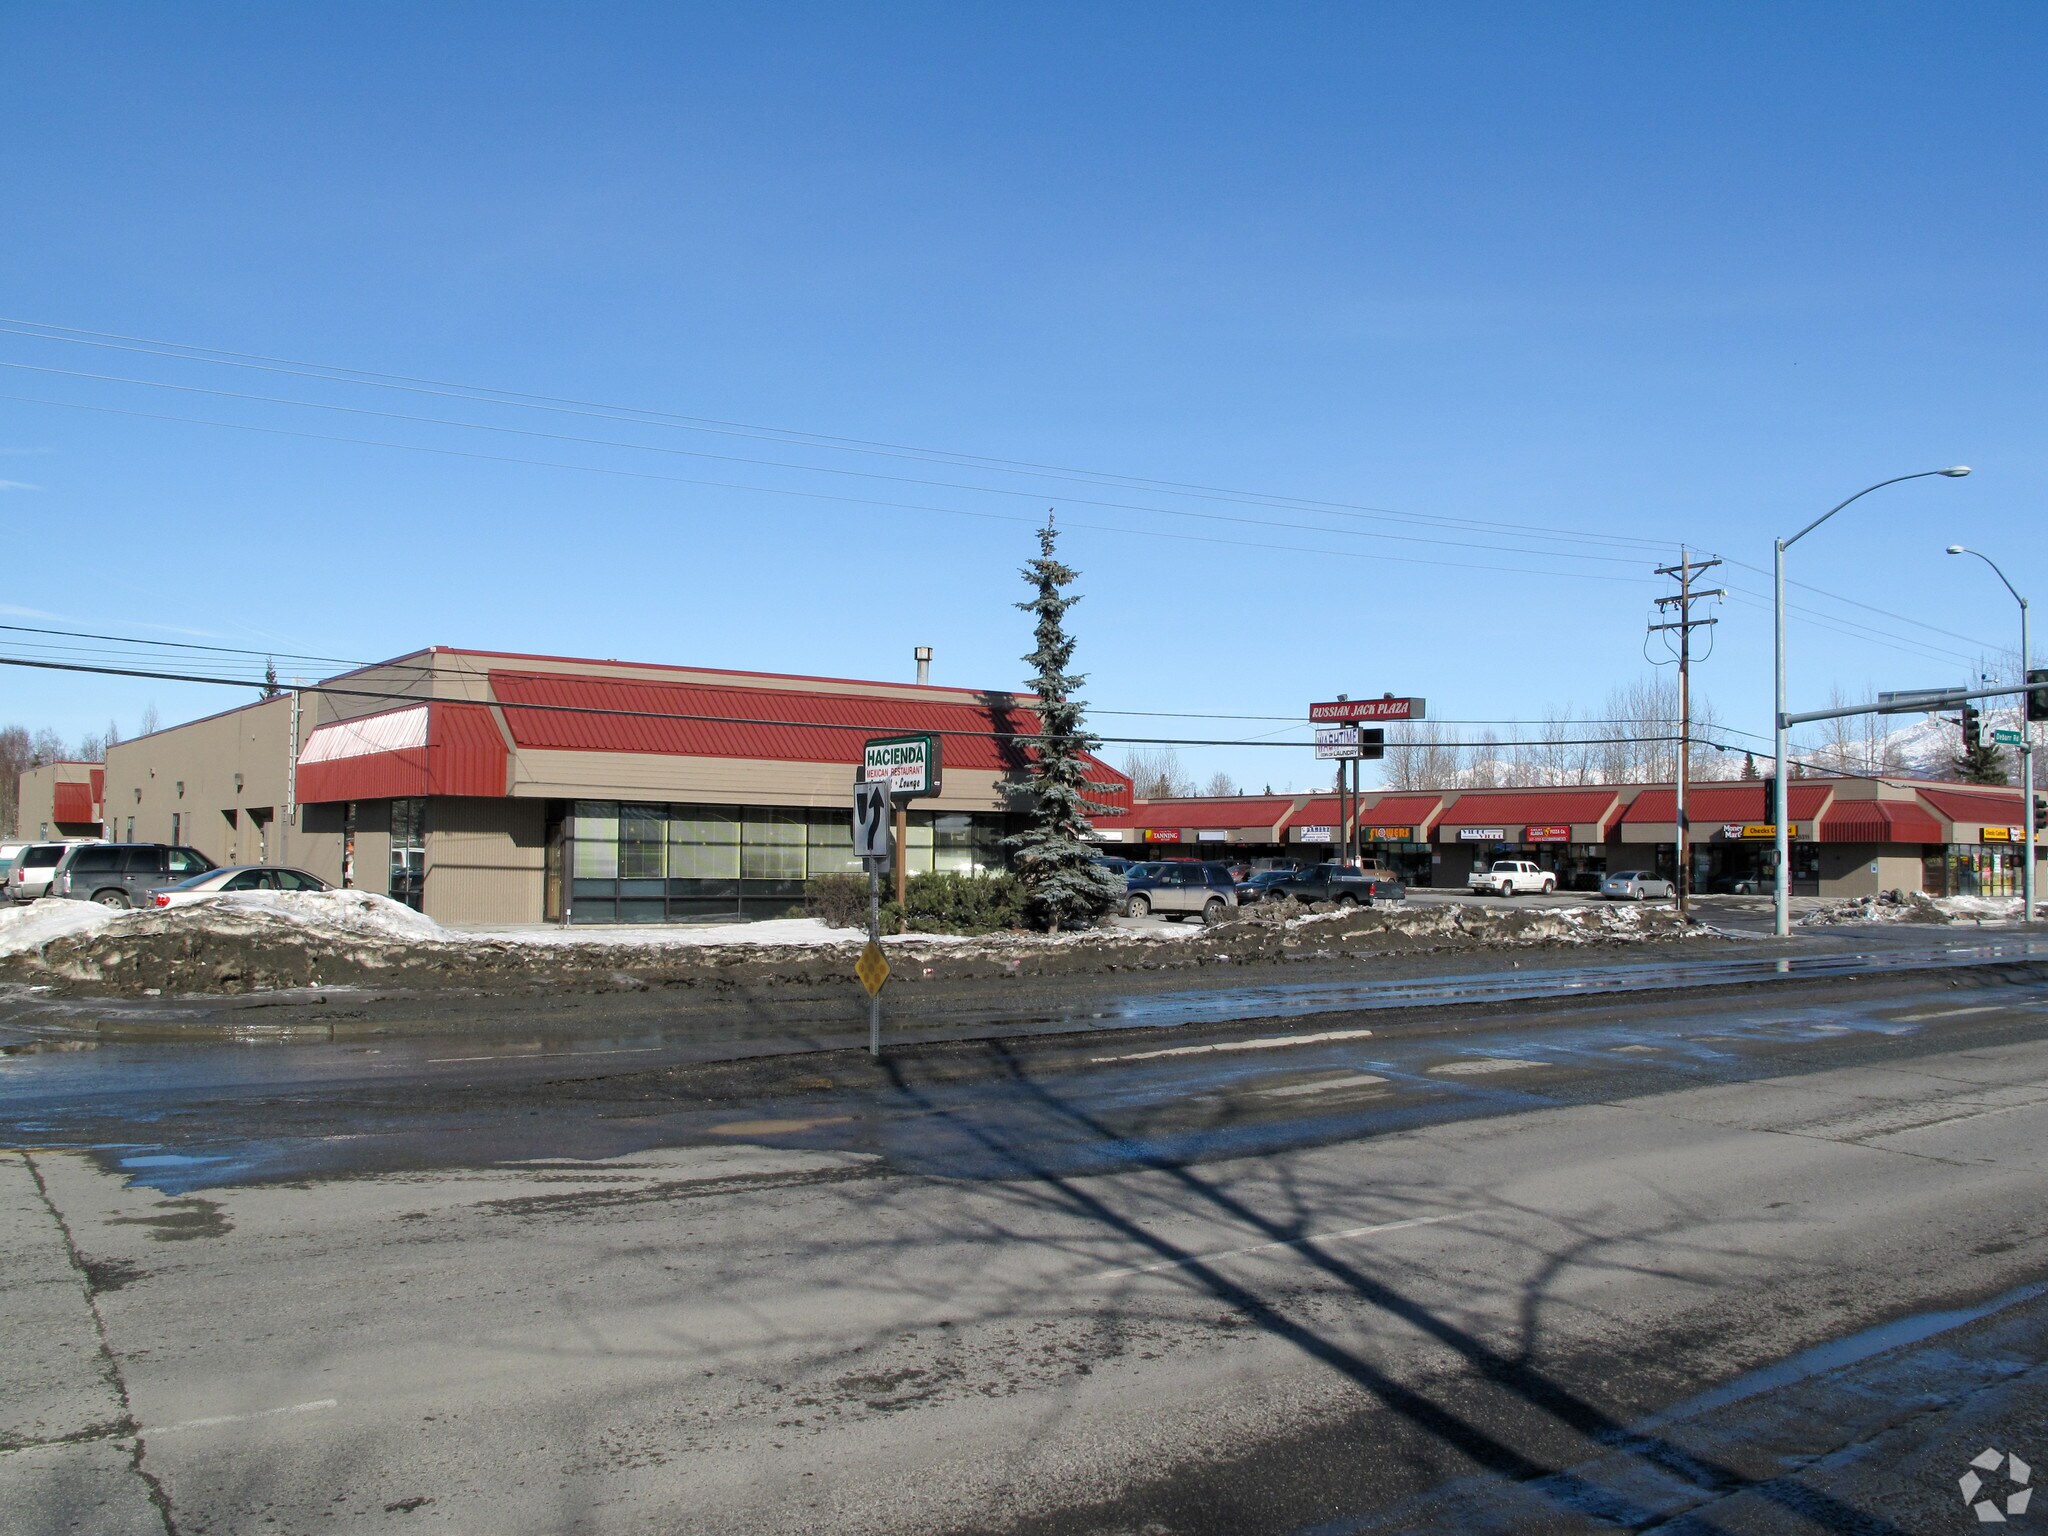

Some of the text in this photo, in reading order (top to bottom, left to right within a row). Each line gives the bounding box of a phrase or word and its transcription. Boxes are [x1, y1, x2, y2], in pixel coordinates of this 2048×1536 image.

[1312, 702, 1409, 718] RUSSIAN JACK PLAZA
[867, 746, 924, 767] HACIENDA
[1333, 749, 1358, 757] LAUNDRY
[866, 765, 924, 779] MEXICAN RESTAURANT
[898, 777, 920, 789] Lounge
[1723, 824, 1744, 833] Money
[1153, 831, 1179, 839] TANNING
[1724, 831, 1743, 839] Mart
